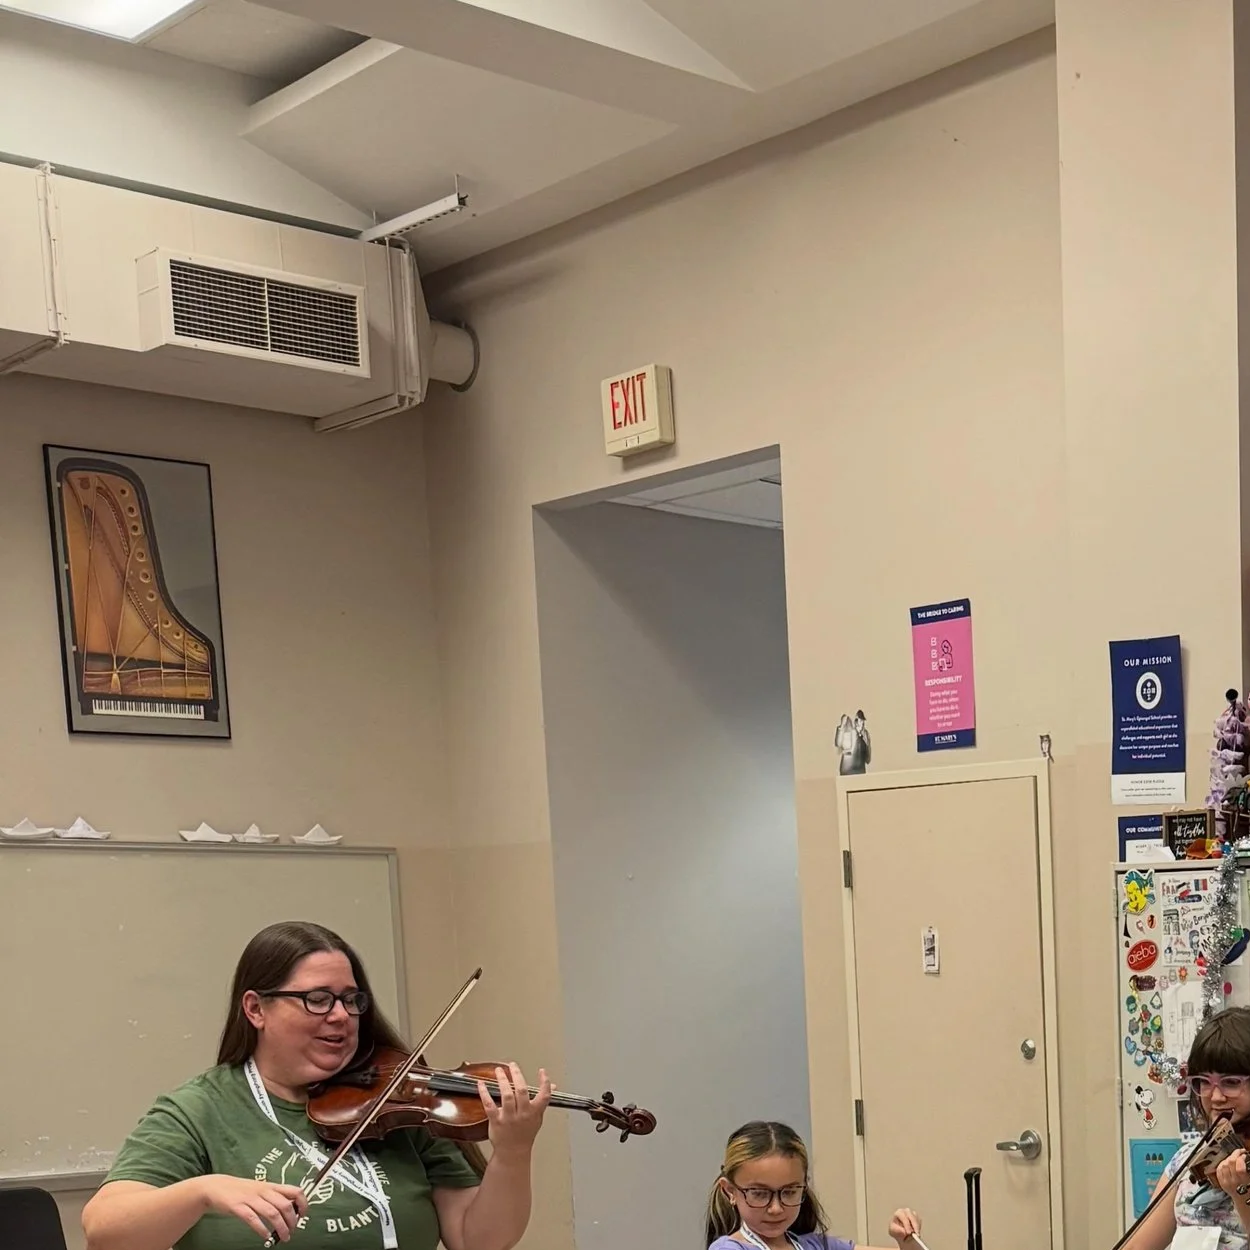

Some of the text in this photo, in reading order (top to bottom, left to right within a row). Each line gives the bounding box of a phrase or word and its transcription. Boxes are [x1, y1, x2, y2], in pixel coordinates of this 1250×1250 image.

[610, 372, 646, 430] EXIT
[1142, 656, 1172, 666] MISSION
[262, 1147, 283, 1165] THE
[371, 1161, 391, 1185] ALIVE
